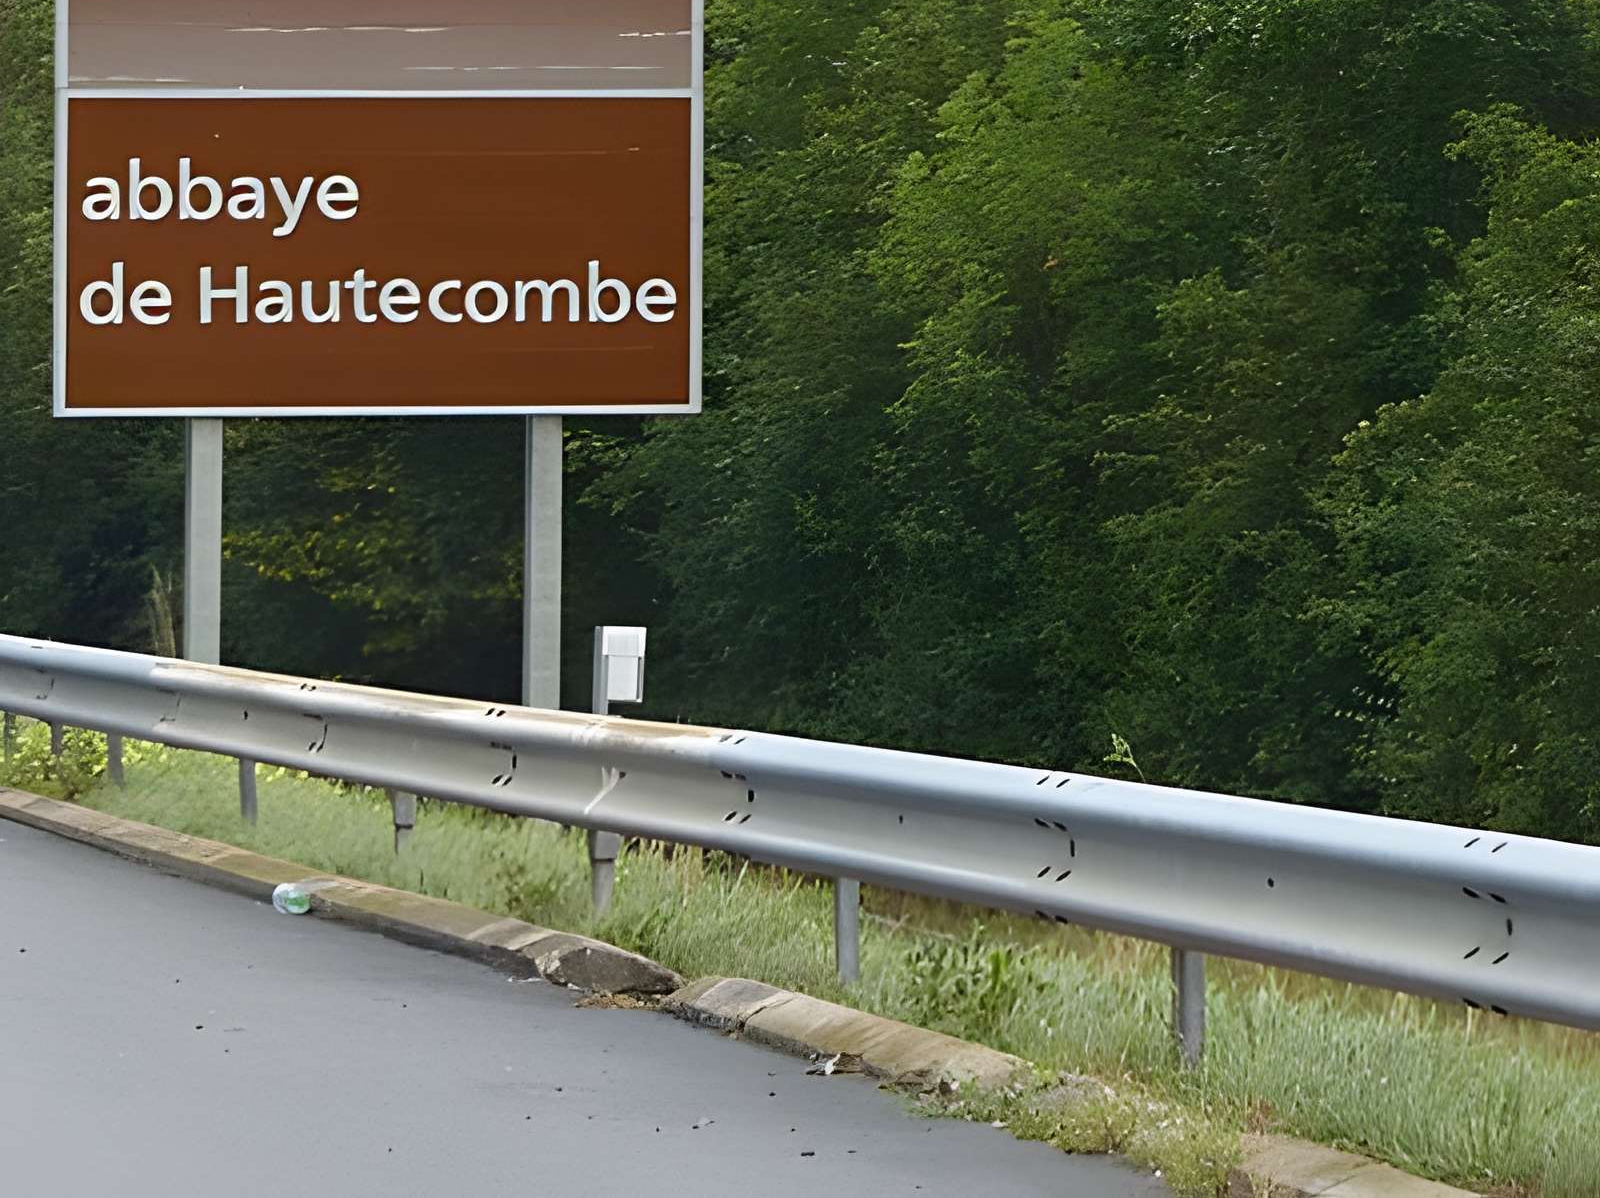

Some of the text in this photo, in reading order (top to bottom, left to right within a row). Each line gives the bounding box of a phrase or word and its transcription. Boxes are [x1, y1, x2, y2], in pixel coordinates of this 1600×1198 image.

[82, 158, 359, 236] abbaye
[80, 260, 677, 325] de Hautecombe
